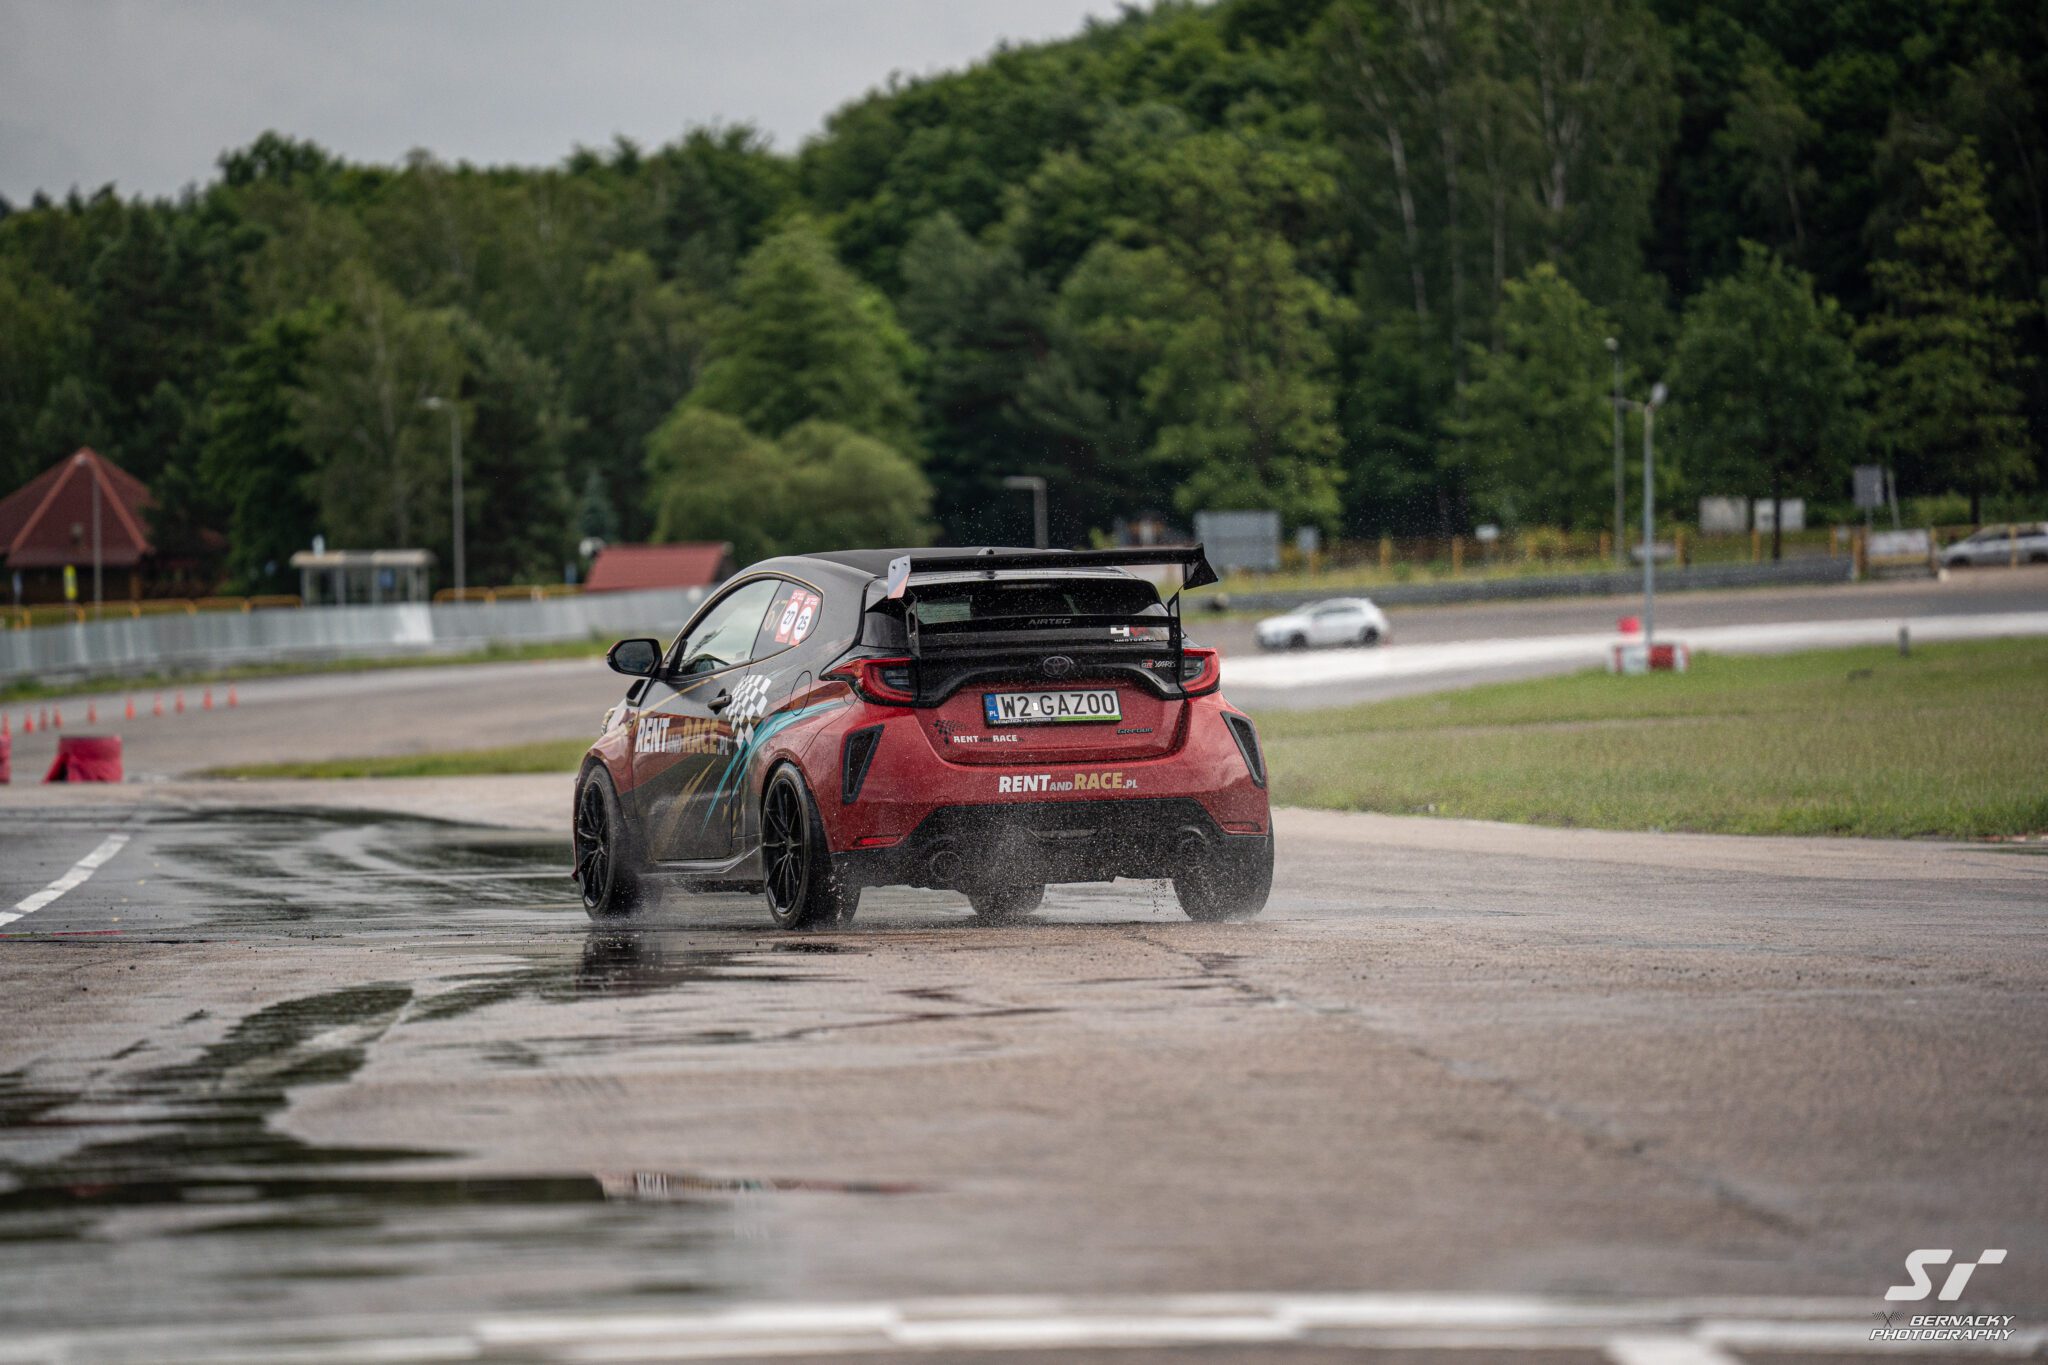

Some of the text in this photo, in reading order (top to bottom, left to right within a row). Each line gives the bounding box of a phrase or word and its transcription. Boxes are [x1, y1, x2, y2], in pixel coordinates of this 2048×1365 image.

[782, 610, 796, 625] 27
[796, 615, 809, 631] 25
[1154, 660, 1176, 668] YARIS
[1000, 696, 1031, 717] W2
